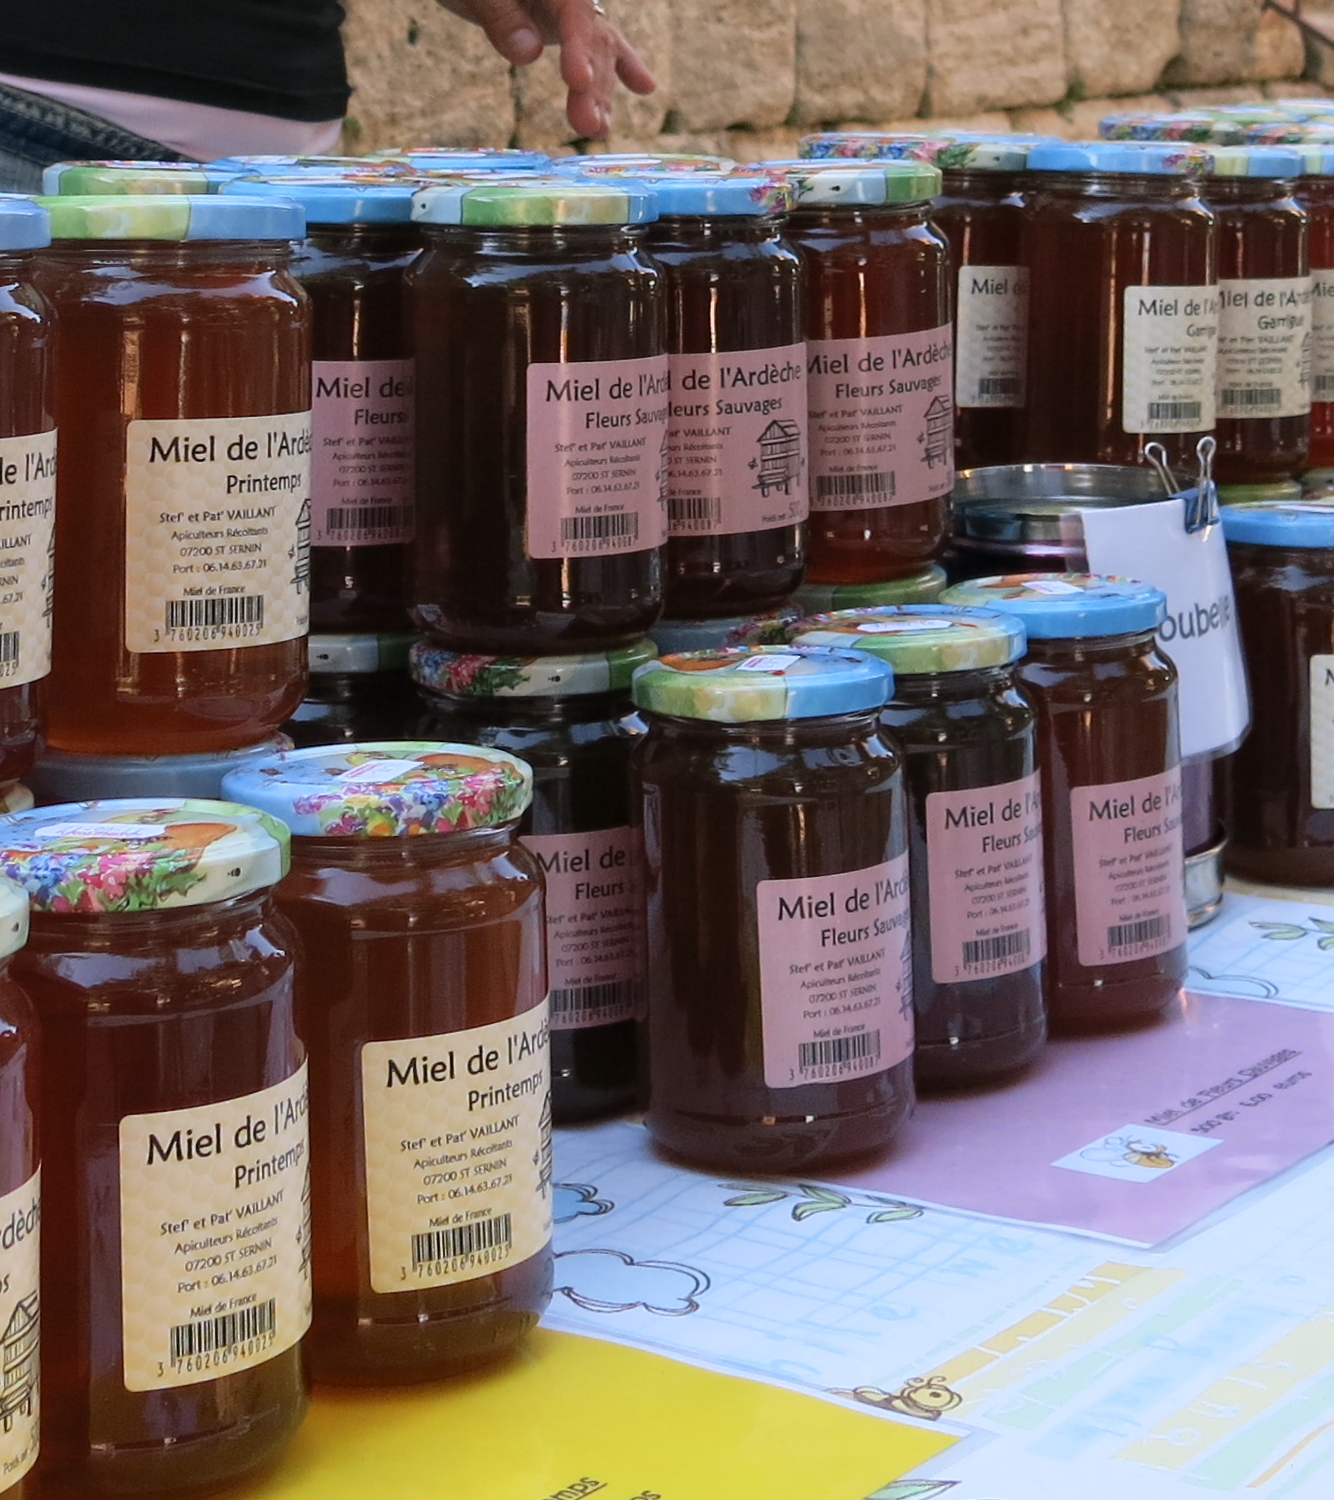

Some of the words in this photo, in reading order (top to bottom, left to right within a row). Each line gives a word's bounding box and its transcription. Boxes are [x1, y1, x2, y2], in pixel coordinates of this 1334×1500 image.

[971, 279, 1008, 295] Miel
[1138, 299, 1178, 316] Miel
[1184, 301, 1200, 316] de
[1254, 292, 1275, 307] de
[858, 357, 884, 372] de
[316, 377, 369, 398] Miel
[380, 376, 405, 398] de
[682, 369, 710, 391] de
[720, 362, 801, 388] l'Ardèche
[835, 383, 884, 399] Fleurs
[889, 375, 941, 394] Sauvages
[546, 378, 600, 402] Miel
[610, 377, 632, 399] de
[355, 409, 404, 425] Fleurs
[668, 403, 709, 417] leurs
[716, 397, 782, 415] Sauvages
[586, 412, 631, 429] Fleurs
[149, 435, 215, 463] Miel
[227, 433, 258, 460] de
[227, 473, 301, 494] Printemps
[188, 513, 199, 522] et
[227, 506, 276, 519] VAILLANT
[180, 546, 212, 556] 07200
[215, 546, 225, 555] ST
[229, 543, 261, 554] SERNIN
[945, 803, 994, 830] Miel
[1002, 799, 1021, 821] de
[1089, 795, 1134, 821] Miel
[1142, 792, 1162, 813] de
[982, 834, 1021, 853] Fleurs
[1124, 824, 1161, 844] Fleurs
[537, 849, 590, 873] Miel
[600, 846, 626, 869] de
[576, 882, 624, 900] Fleurs
[778, 892, 836, 921] Miel
[845, 888, 869, 913] de
[821, 925, 869, 947] Fleurs
[386, 1051, 454, 1088] Miel
[467, 1045, 498, 1075] de
[468, 1068, 543, 1111] Printemps
[147, 1123, 221, 1165] Miel
[234, 1115, 265, 1148] de
[431, 1136, 442, 1147] et
[469, 1115, 518, 1140] VAILLANT
[234, 1140, 305, 1189] Printemps
[413, 1151, 468, 1169] Apiculteurs
[424, 1171, 457, 1186] 07200
[460, 1167, 471, 1179] ST
[473, 1158, 507, 1176] SERNIN
[417, 1193, 439, 1204] Port
[429, 1215, 450, 1227] Miel
[453, 1213, 464, 1224] de
[466, 1207, 491, 1221] France
